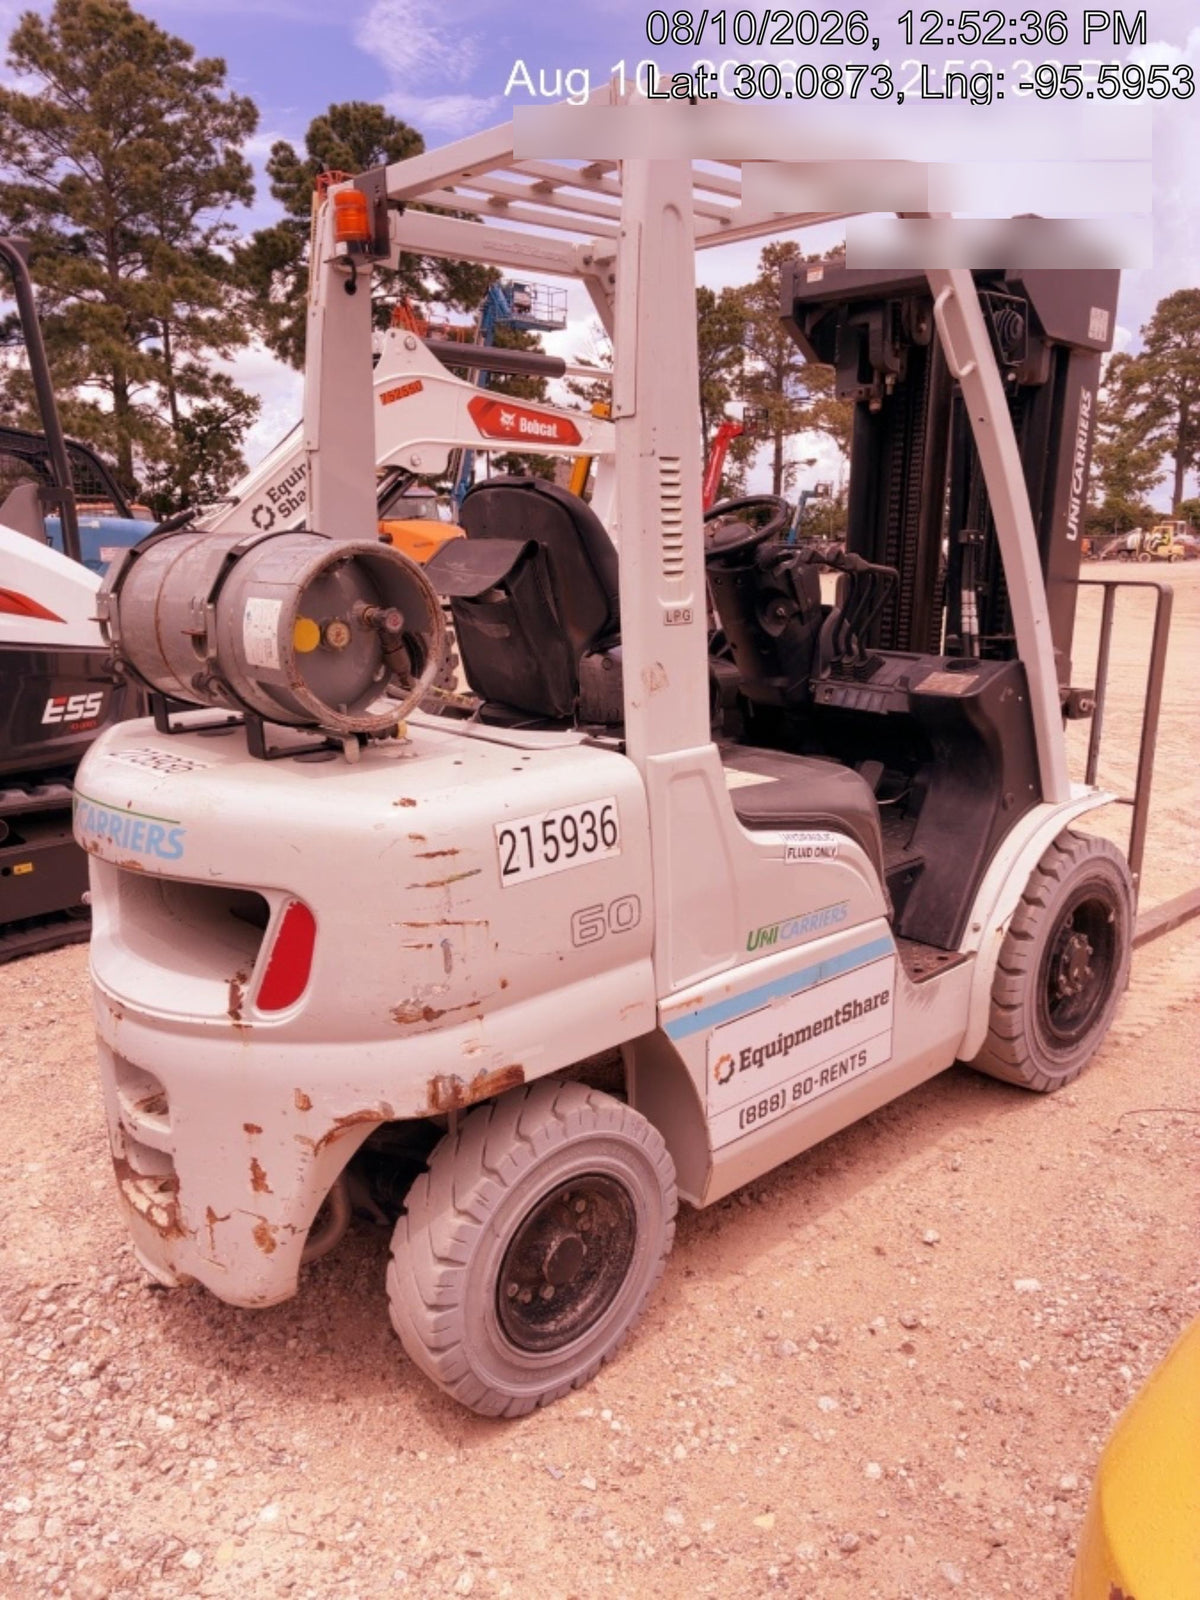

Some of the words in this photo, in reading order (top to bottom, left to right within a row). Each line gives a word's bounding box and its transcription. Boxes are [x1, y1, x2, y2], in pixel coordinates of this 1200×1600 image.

[519, 417, 559, 438] Bobcat
[666, 609, 691, 623] LPG
[499, 805, 617, 876] 215936
[570, 894, 641, 948] 60
[738, 989, 890, 1072] EquipmentShare
[738, 1089, 787, 1129] (888)
[792, 1050, 867, 1101] 80-RENTS
